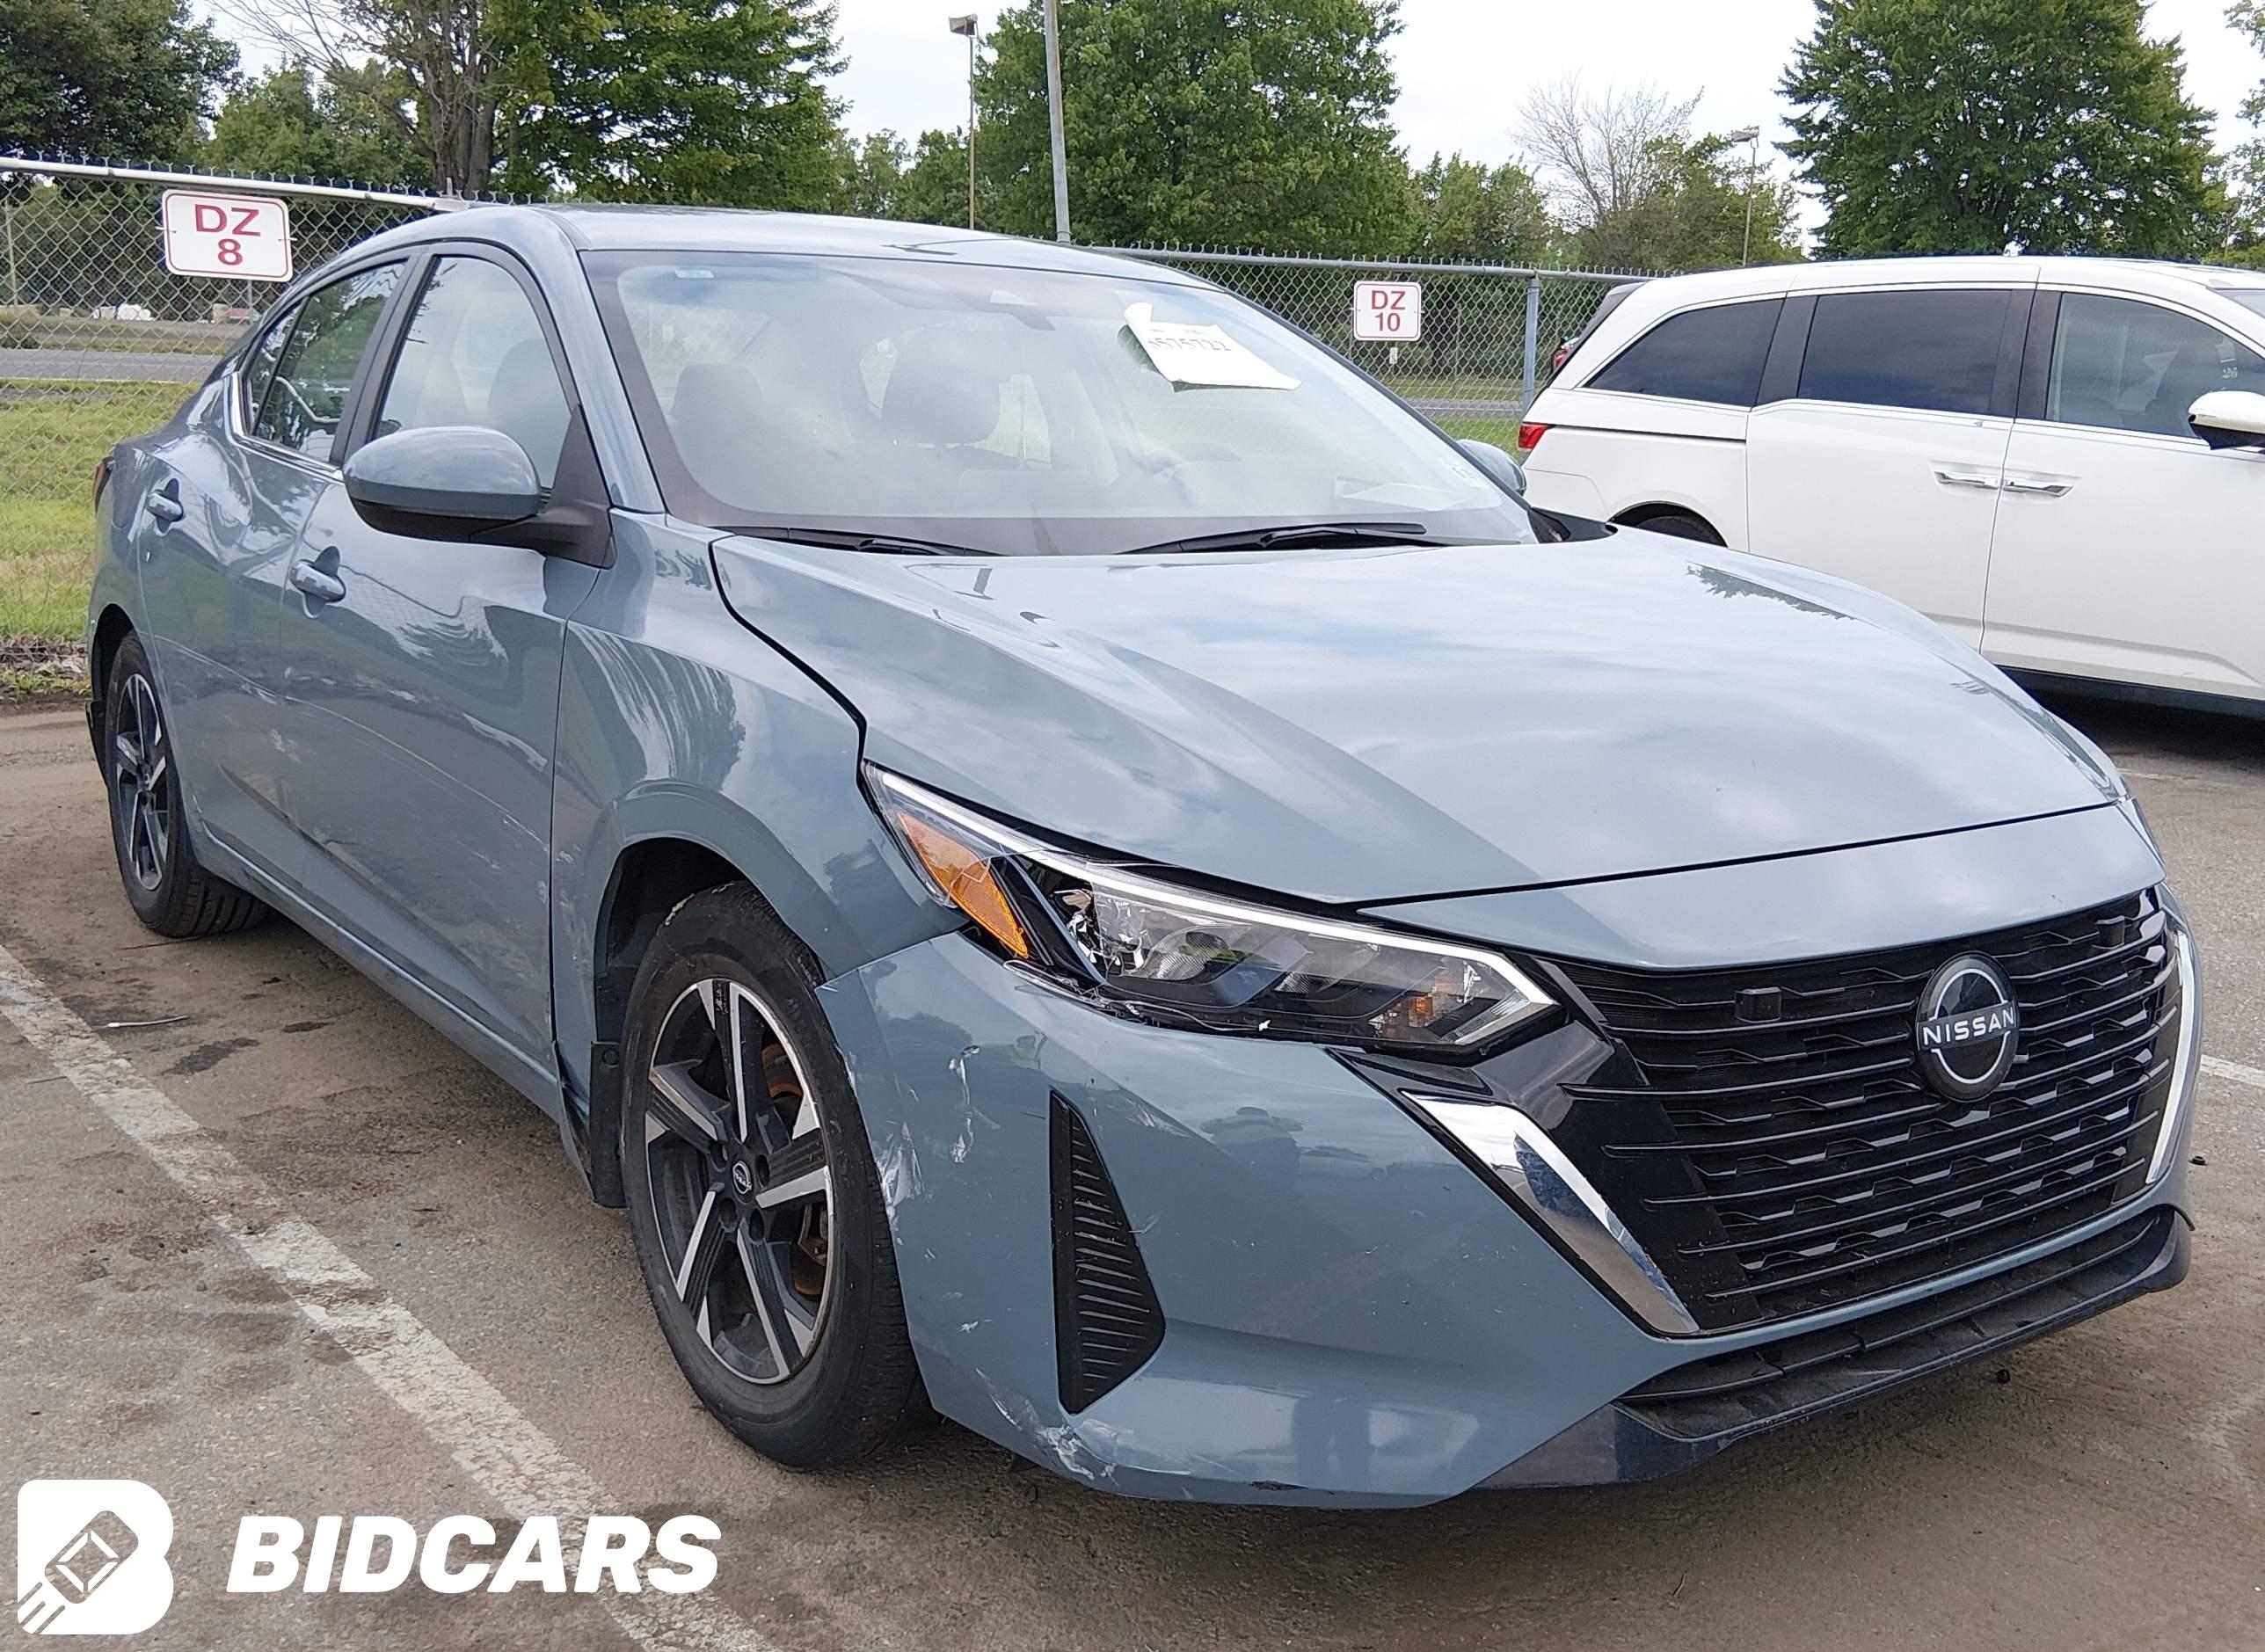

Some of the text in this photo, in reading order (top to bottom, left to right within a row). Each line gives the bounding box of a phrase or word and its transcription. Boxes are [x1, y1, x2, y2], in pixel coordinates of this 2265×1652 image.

[194, 203, 261, 237] DZ
[217, 238, 244, 266] 8
[1371, 289, 1407, 310] DZ
[1374, 311, 1401, 332] 10
[1922, 1007, 2014, 1045] NISSAN
